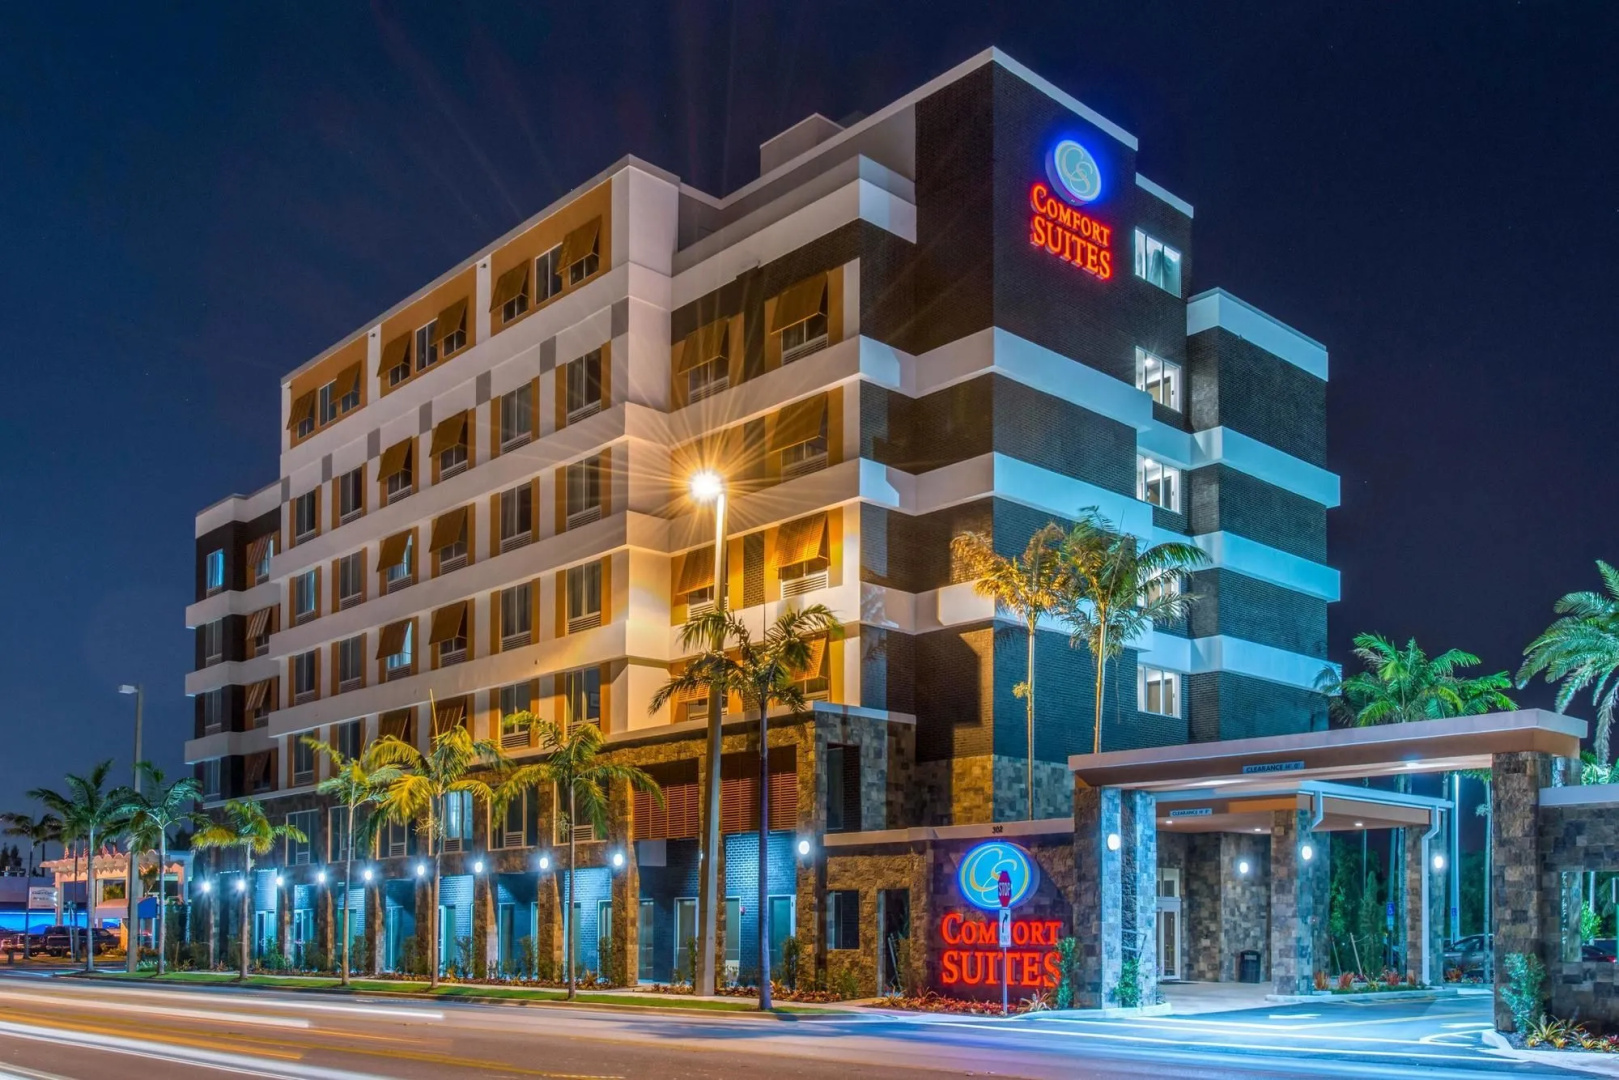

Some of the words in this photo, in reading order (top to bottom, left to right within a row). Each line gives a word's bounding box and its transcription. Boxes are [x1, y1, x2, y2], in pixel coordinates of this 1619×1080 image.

[1032, 185, 1111, 247] COMFORT
[1033, 216, 1111, 279] SUITES
[1246, 764, 1284, 773] CLEARANCE
[998, 882, 1011, 897] STOP
[942, 913, 1062, 946] COMORT
[942, 951, 1062, 988] SUITES
